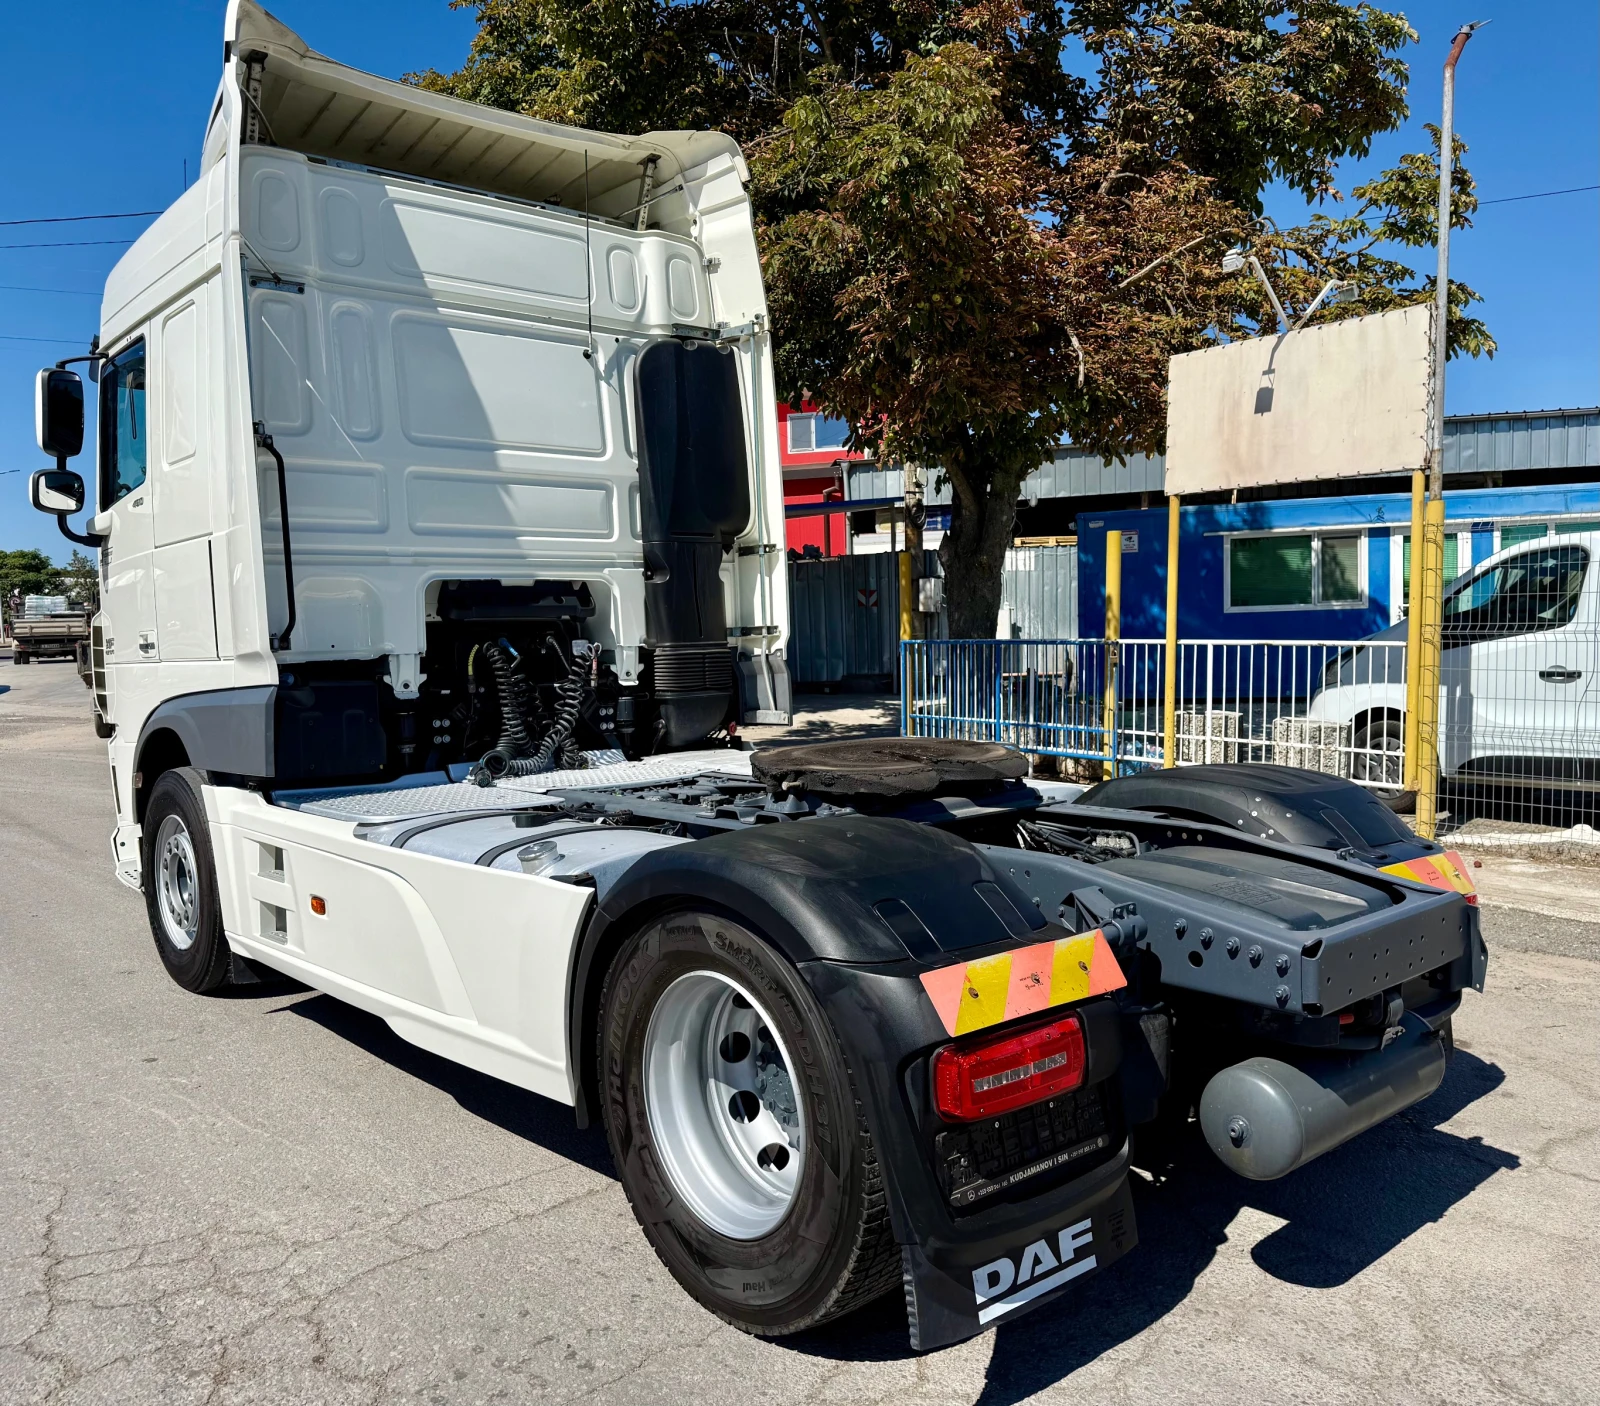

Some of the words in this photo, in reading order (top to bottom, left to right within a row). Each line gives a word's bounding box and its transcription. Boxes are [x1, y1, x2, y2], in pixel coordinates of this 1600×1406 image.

[1009, 1159, 1054, 1184] KUDJAMANOV
[1057, 1152, 1069, 1164] SIN
[972, 1217, 1094, 1305] DAF
[742, 1281, 766, 1293] Haul
